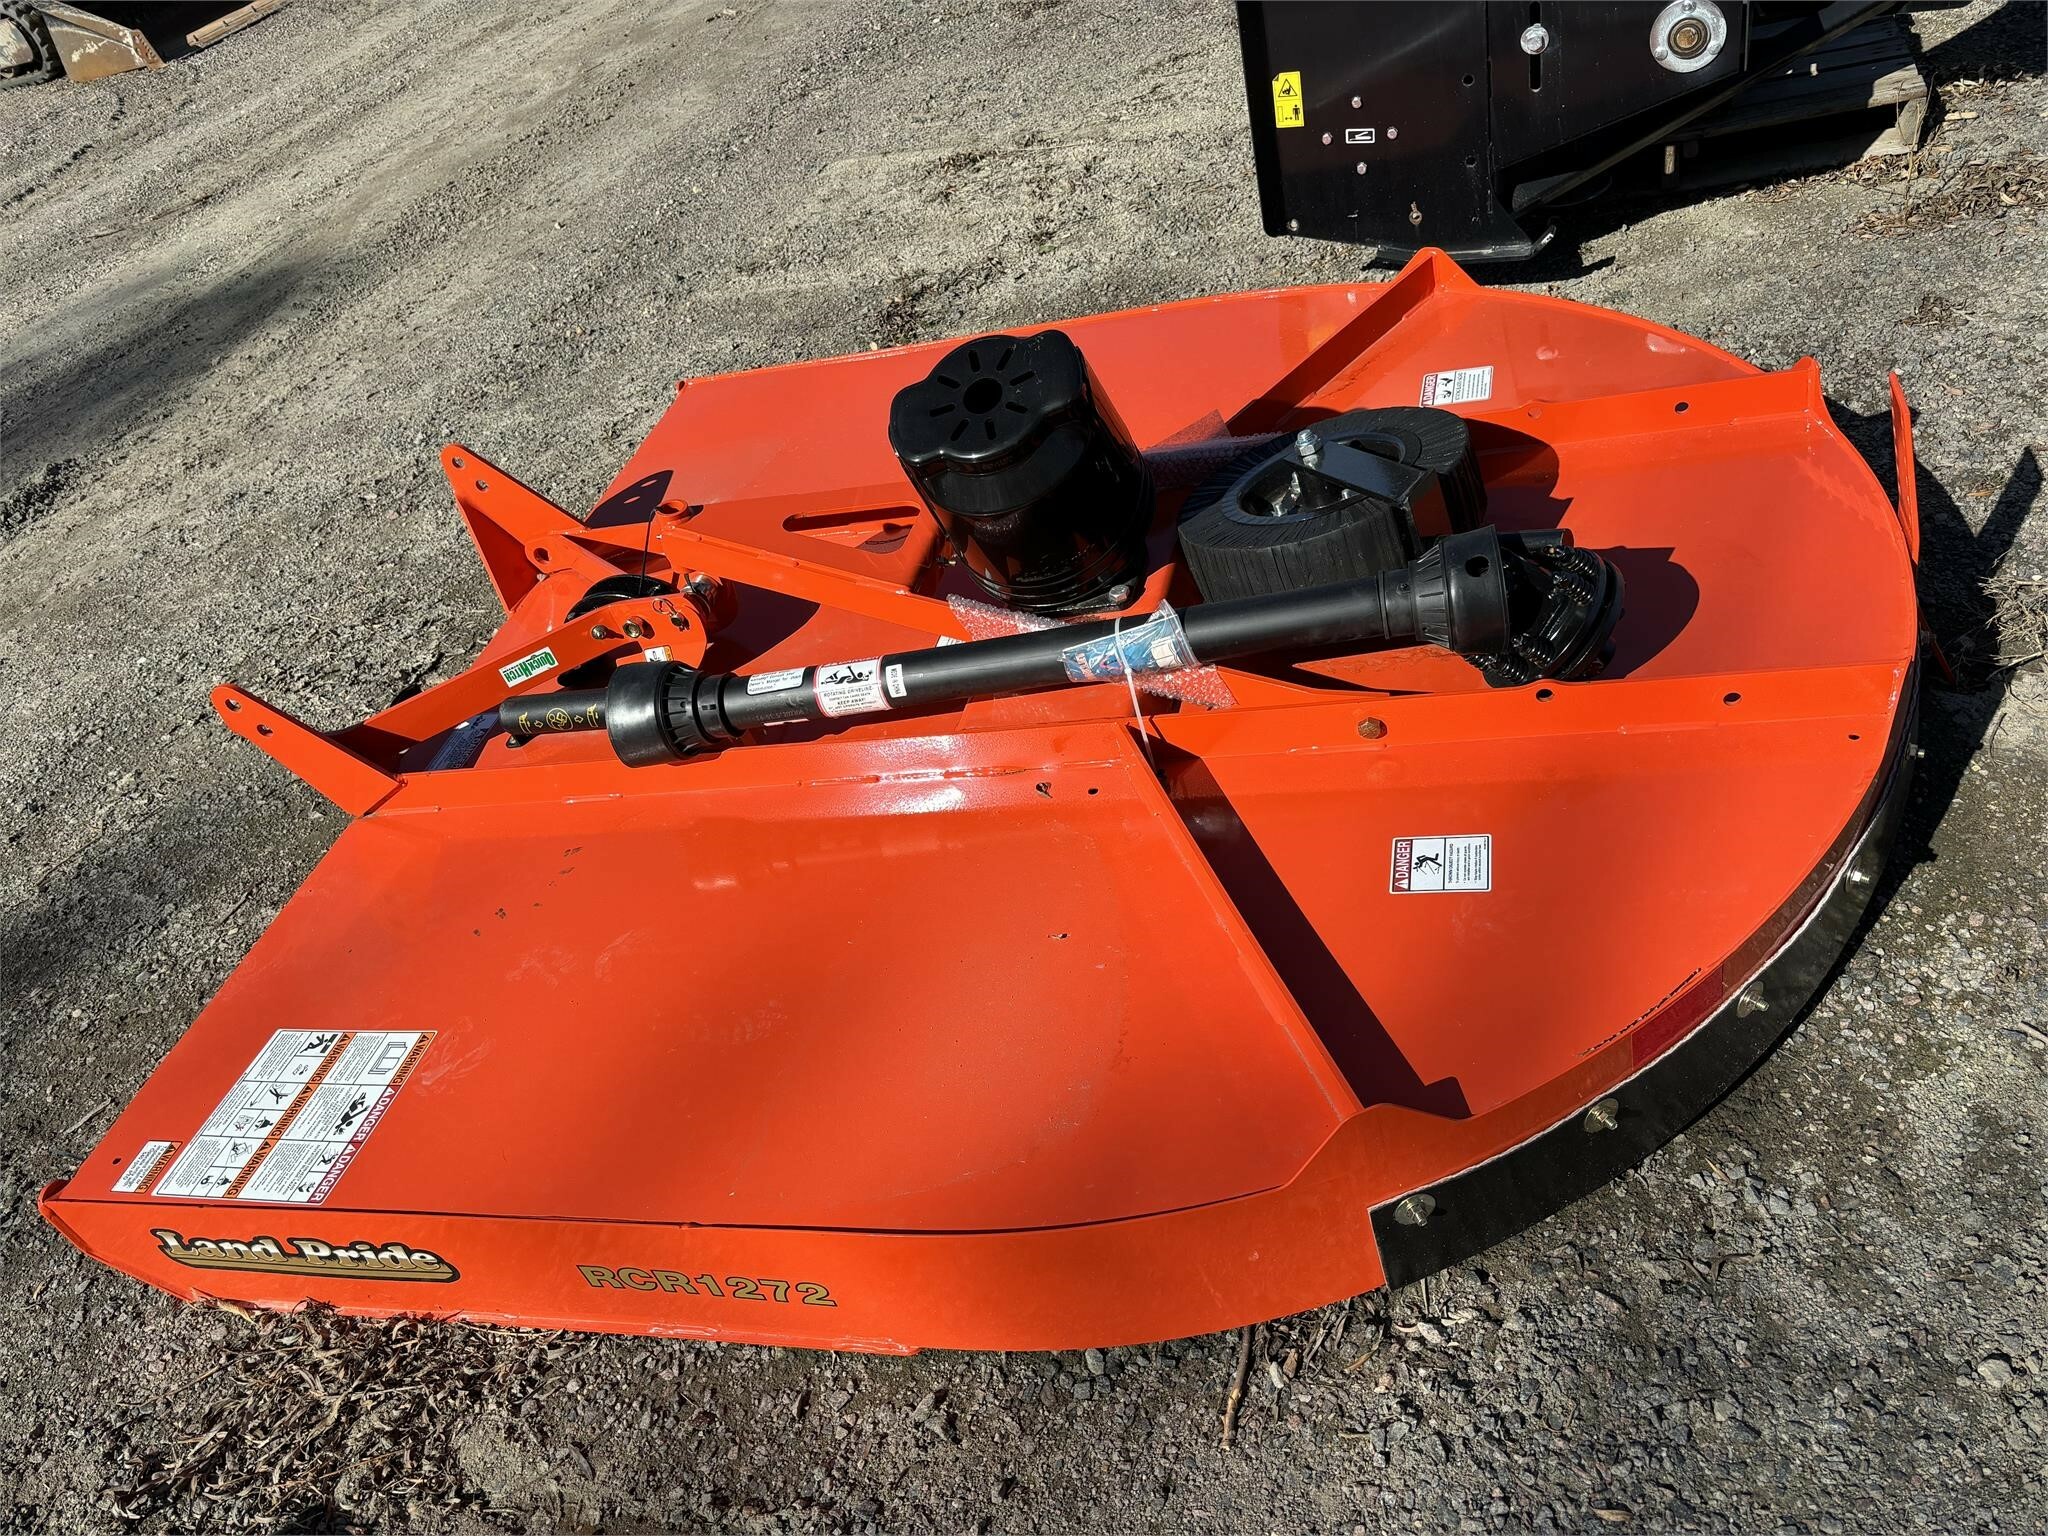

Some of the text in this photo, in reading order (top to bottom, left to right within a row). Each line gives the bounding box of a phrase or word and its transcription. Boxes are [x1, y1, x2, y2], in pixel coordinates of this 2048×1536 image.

[1395, 840, 1412, 879] DANGER
[310, 1043, 349, 1083] WARNING
[392, 1040, 425, 1085] WARNING
[271, 1094, 308, 1137] WARNING
[354, 1096, 391, 1142] DANGER
[138, 1154, 172, 1190] WARNING
[226, 1150, 267, 1196] WARNING
[311, 1152, 351, 1202] DANGER
[156, 1230, 442, 1271] Land Pride
[576, 1264, 838, 1308] RCR1272
